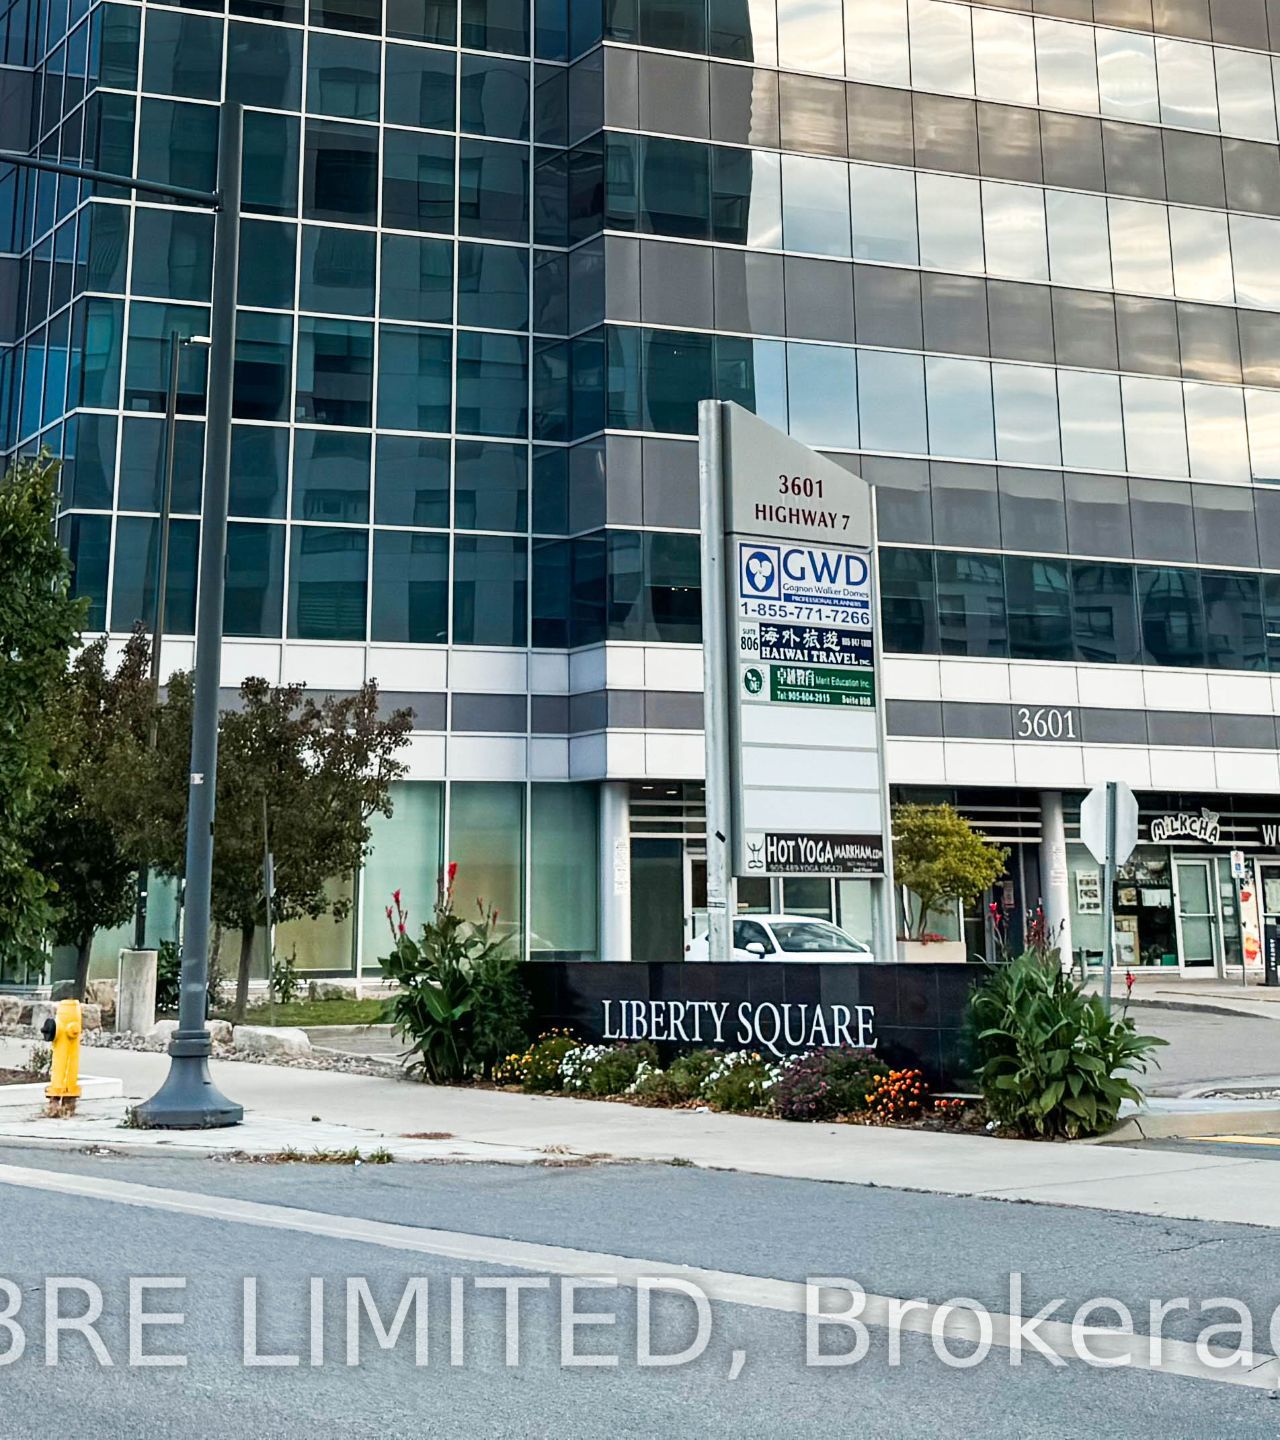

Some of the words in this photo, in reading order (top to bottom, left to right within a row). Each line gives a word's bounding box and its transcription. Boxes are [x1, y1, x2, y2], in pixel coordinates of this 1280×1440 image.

[779, 474, 823, 498] 3601
[755, 503, 837, 528] HIGHWAY
[842, 514, 850, 530] 7
[783, 548, 868, 586] GWD
[783, 582, 813, 593] Gagnon
[815, 586, 841, 595] Walker
[843, 588, 869, 598] Domes
[741, 601, 870, 625] 1-855-771-7266
[740, 636, 759, 651] 806
[761, 647, 808, 661] HAIWAI
[811, 651, 858, 665] TRAVEL
[831, 677, 859, 687] Education
[1018, 708, 1076, 738] 3601
[767, 836, 795, 863] HOT
[798, 837, 834, 863] YOGA
[602, 1000, 730, 1043] LIBERTY
[737, 1001, 878, 1058] SQUARE
